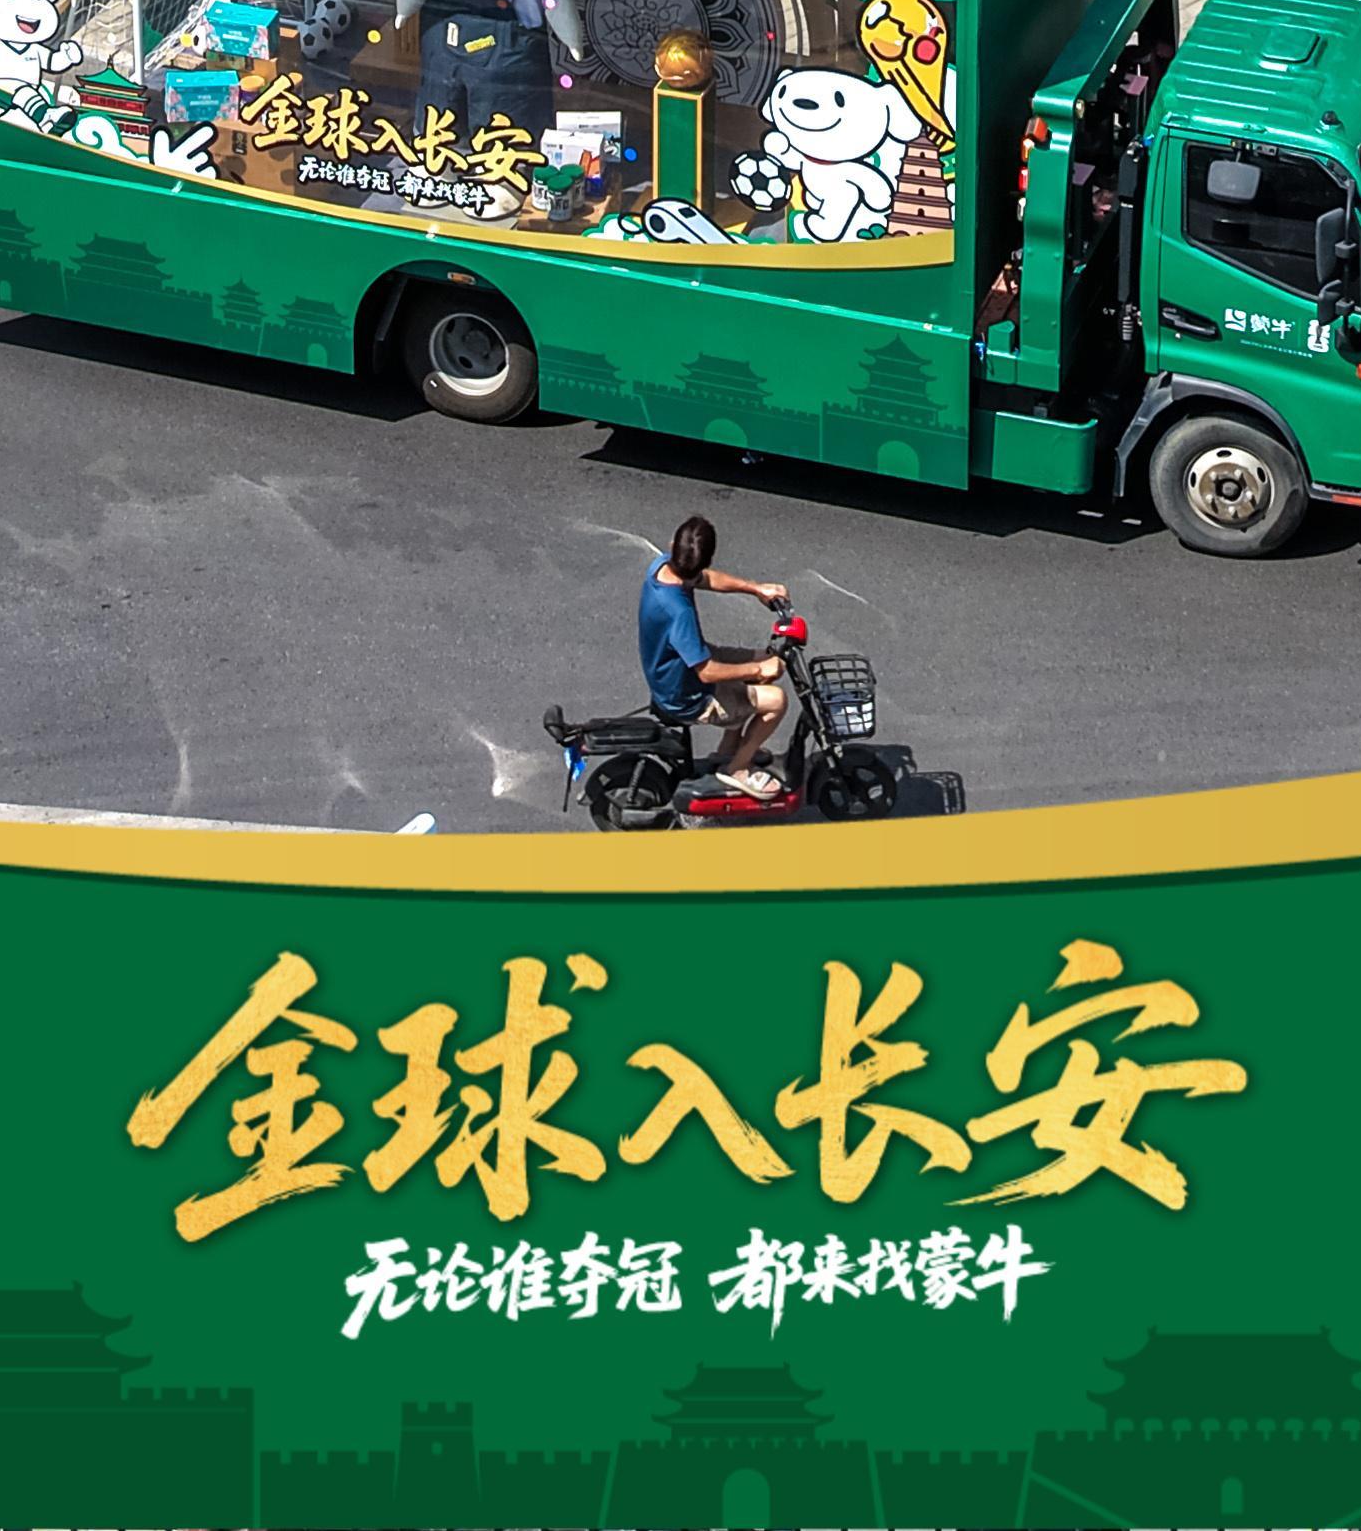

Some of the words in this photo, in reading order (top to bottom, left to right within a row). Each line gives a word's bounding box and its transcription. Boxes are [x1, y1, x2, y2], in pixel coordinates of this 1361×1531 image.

[240, 73, 549, 194] 全球入长安
[298, 156, 392, 192] 无论谁夺冠
